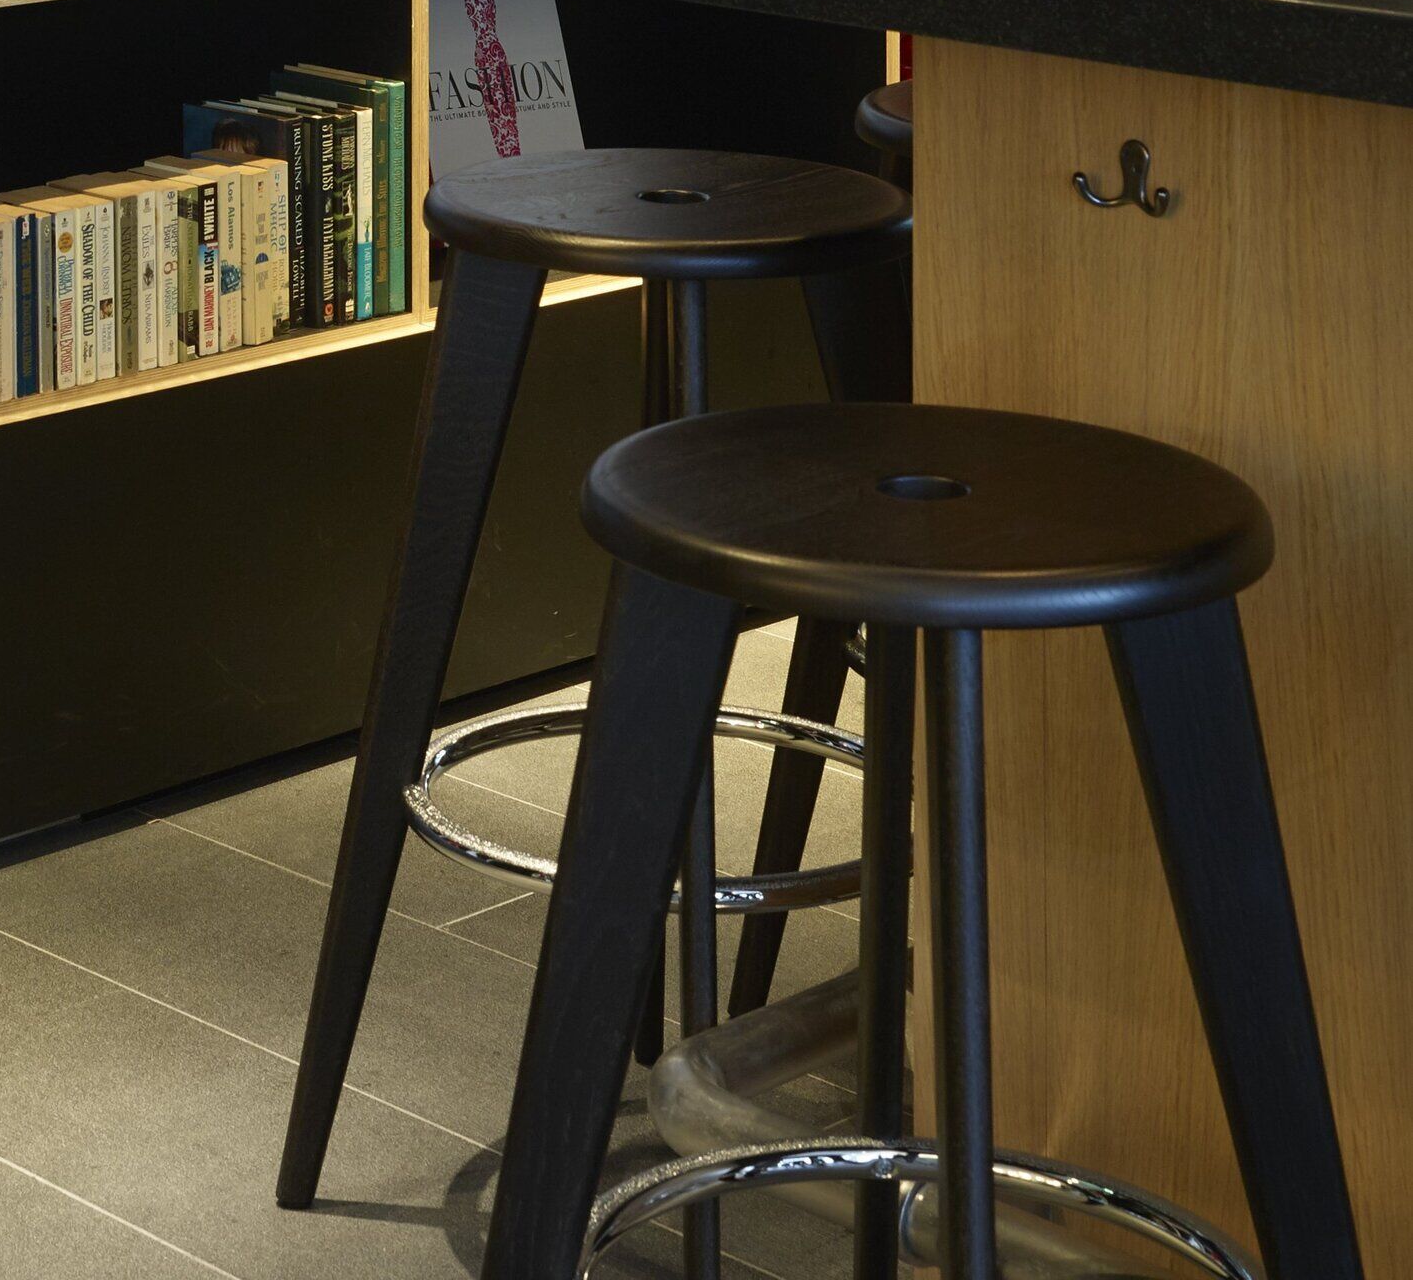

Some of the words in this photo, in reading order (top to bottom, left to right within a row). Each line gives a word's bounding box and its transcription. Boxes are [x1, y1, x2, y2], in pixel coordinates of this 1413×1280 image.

[429, 59, 567, 112] FASHION
[429, 114, 443, 123] THE
[444, 110, 477, 121] ULTIMATE
[537, 102, 551, 110] AND
[551, 100, 572, 109] STYLE
[293, 126, 303, 191] RUNNING
[321, 123, 335, 162] STONE
[227, 182, 235, 202] Los
[321, 163, 334, 192] KISS
[204, 199, 216, 241] WHITE
[227, 206, 236, 251] Alamos
[270, 202, 278, 254] MAGIC
[277, 194, 287, 230] SHIP
[293, 194, 303, 246] SCARED
[323, 215, 335, 244] FAYE
[81, 223, 96, 265] SHADOW
[121, 225, 135, 277] WOMEN
[142, 224, 153, 259] EXILES
[163, 225, 172, 252] BRIDE
[277, 234, 287, 255] OF
[82, 267, 95, 281] OF
[204, 250, 216, 284] BLACK
[322, 243, 335, 302] KELLERMAN
[346, 242, 354, 271] DANCING
[58, 255, 68, 299] CORNWELL
[65, 259, 76, 294] PATRICIA
[278, 258, 286, 291] ROBIN
[292, 259, 300, 302] LOWELL
[346, 272, 354, 293] FLOOR
[82, 282, 94, 305] THE
[121, 277, 135, 325] SCARLET
[60, 296, 74, 339] UNNATURAL
[81, 304, 96, 337] CHILD
[60, 338, 74, 376] EXPOSURE
